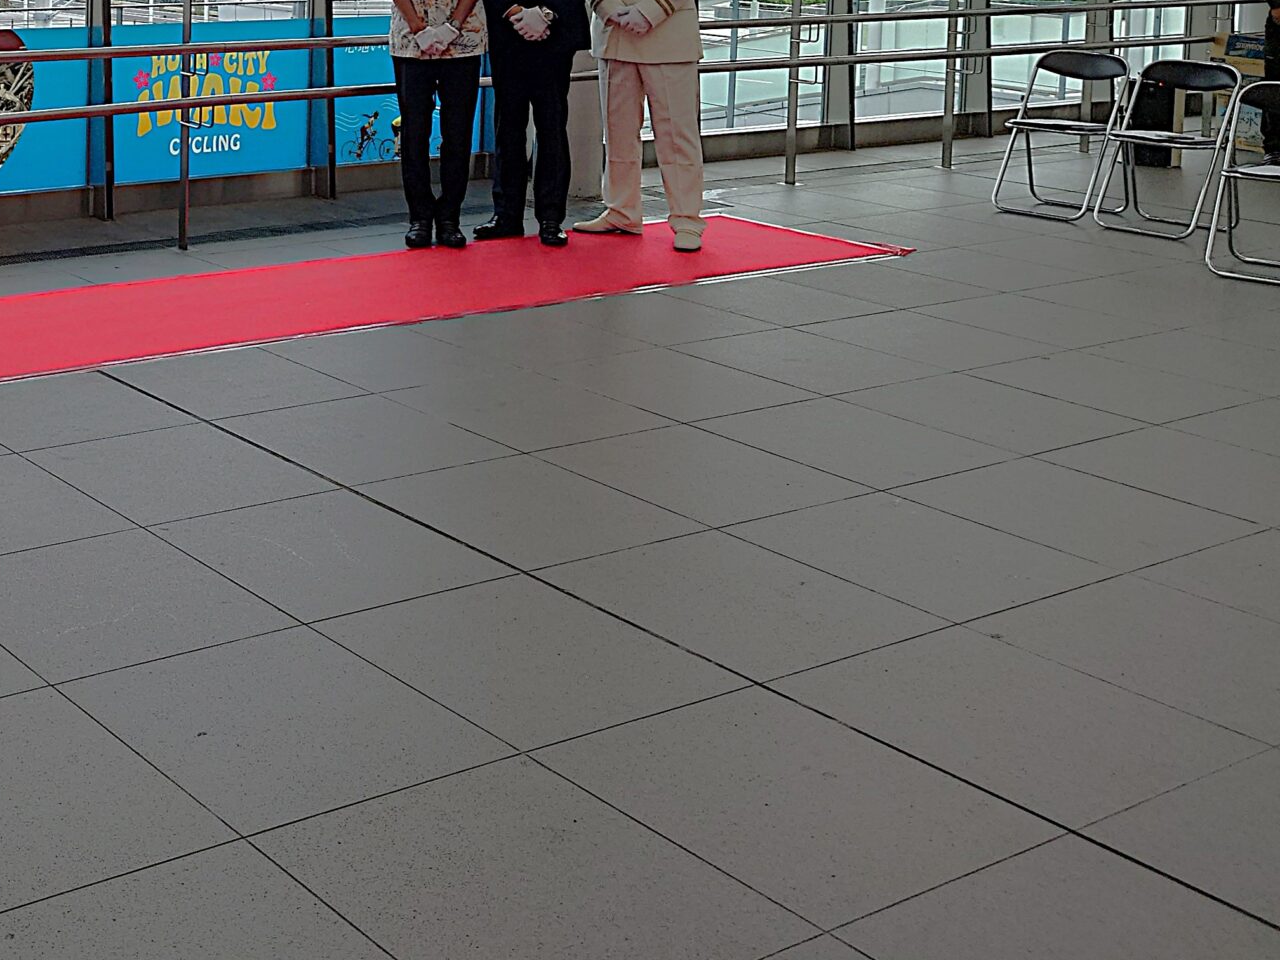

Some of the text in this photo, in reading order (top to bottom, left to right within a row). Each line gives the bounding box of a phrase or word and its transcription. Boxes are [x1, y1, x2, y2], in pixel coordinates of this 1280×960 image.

[223, 50, 271, 76] CITY
[136, 73, 277, 138] IWAKI
[169, 133, 241, 156] CCLING
